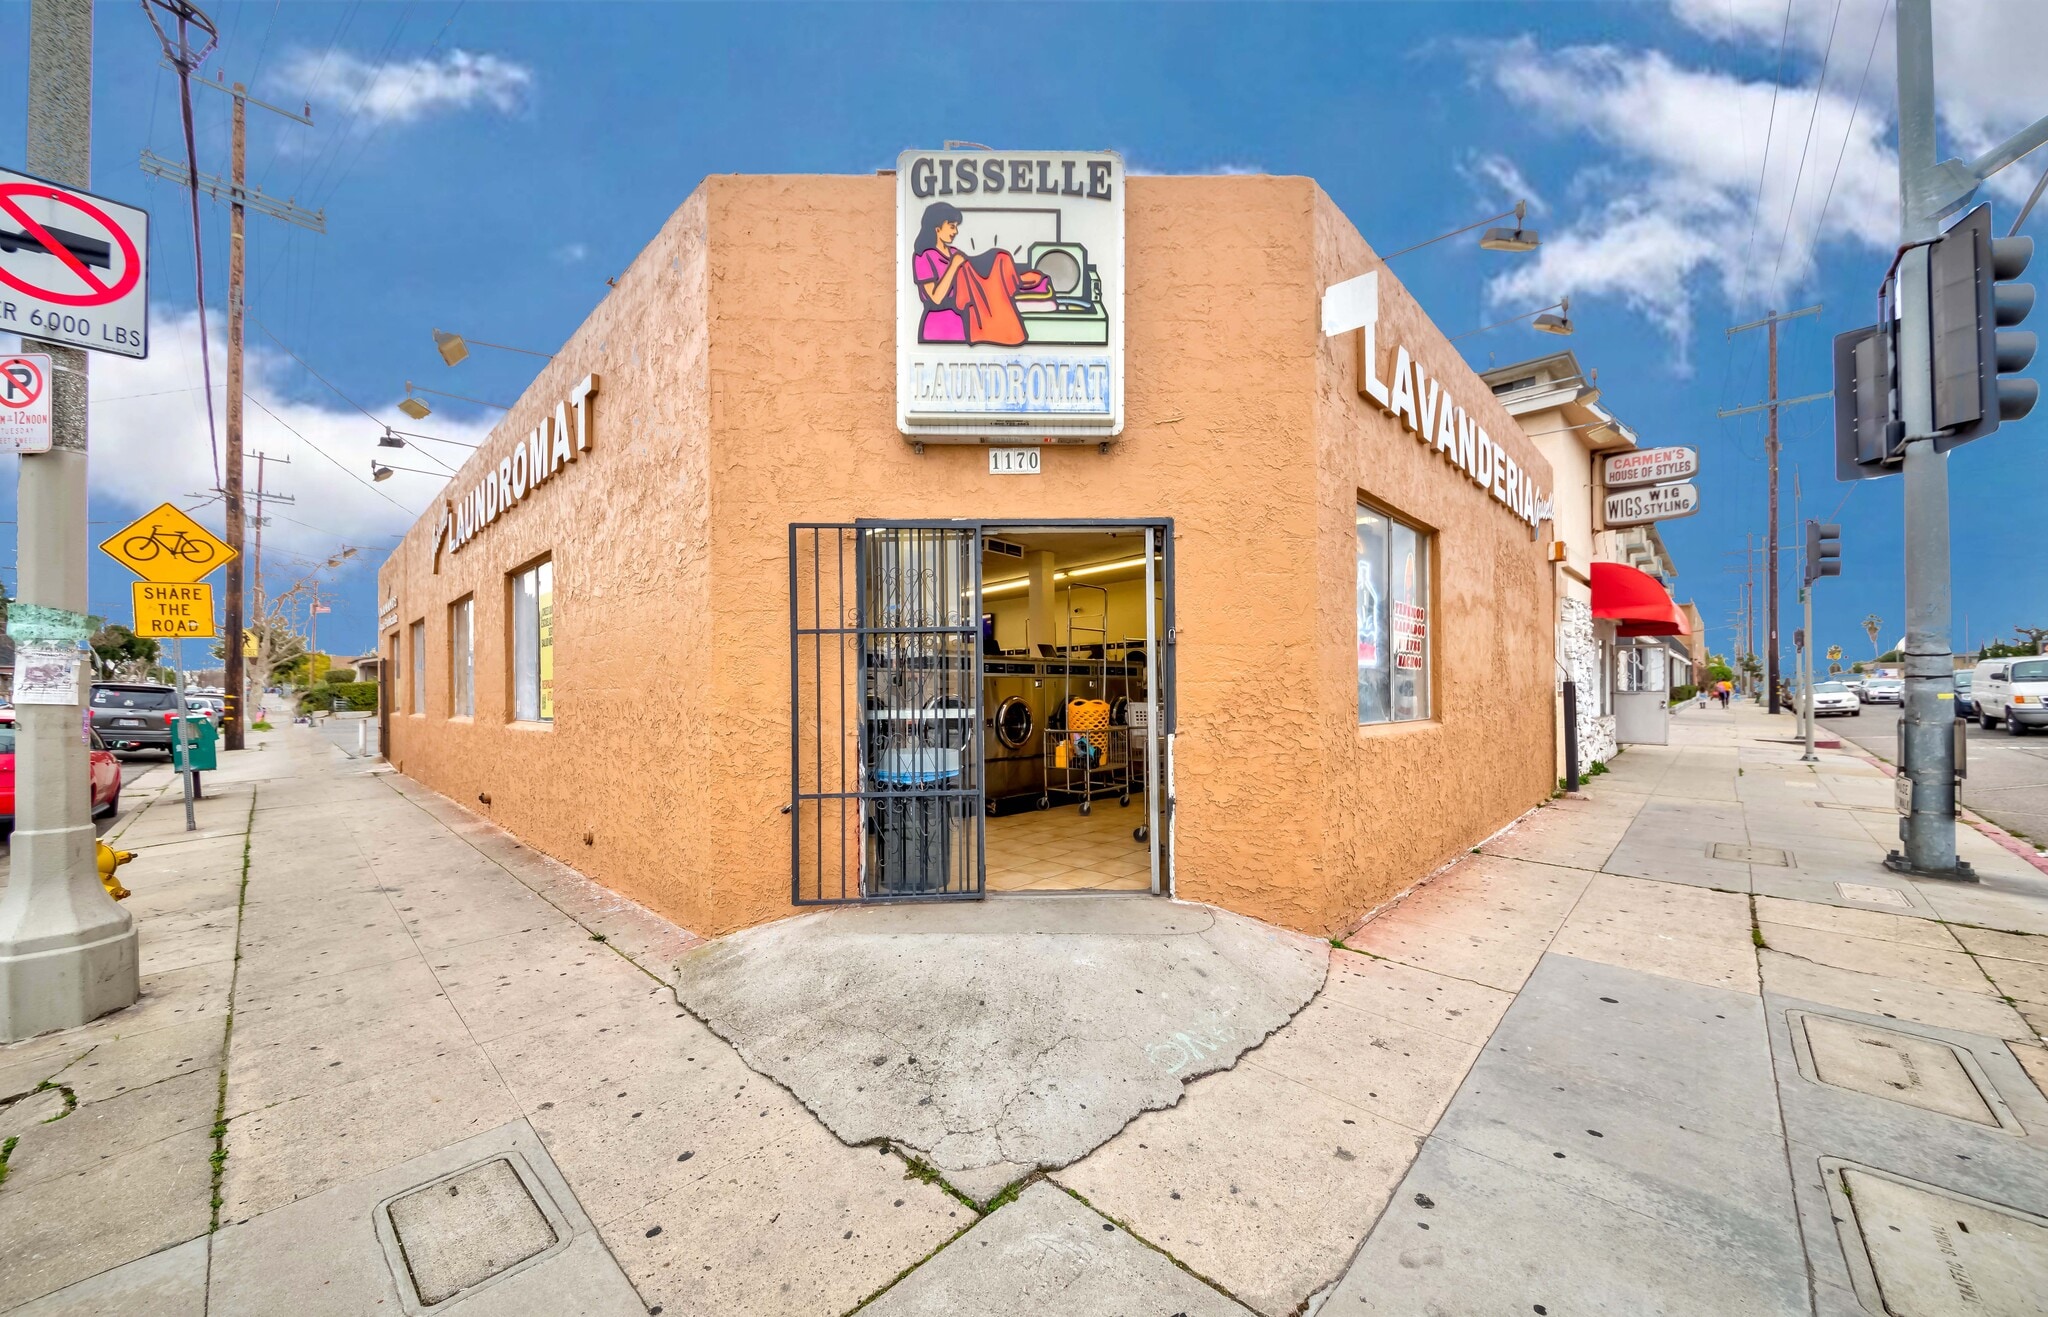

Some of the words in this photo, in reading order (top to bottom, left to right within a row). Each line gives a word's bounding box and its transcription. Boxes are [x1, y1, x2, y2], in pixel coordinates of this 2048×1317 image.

[911, 157, 1112, 201] GISSELLE
[0, 301, 17, 322] R
[103, 323, 141, 347] LBS
[913, 362, 1107, 402] LAUNDROMAT
[1, 427, 34, 435] TUESDAY
[1358, 320, 1536, 528] LAVANDERIA
[449, 373, 599, 554] LAUNDROMAT
[992, 451, 1038, 470] 1170
[1613, 448, 1685, 470] CARMEN'S
[1609, 469, 1639, 482] HOUSE
[1641, 466, 1653, 478] OF
[1656, 460, 1691, 476] STYLES
[1649, 487, 1680, 501] WIG
[1607, 496, 1643, 519] WIGS
[1644, 498, 1690, 515] STYLING
[144, 587, 202, 601] SHARE
[158, 603, 191, 616] THE
[152, 619, 199, 632] ROAD
[1397, 654, 1422, 669] NACHOS
